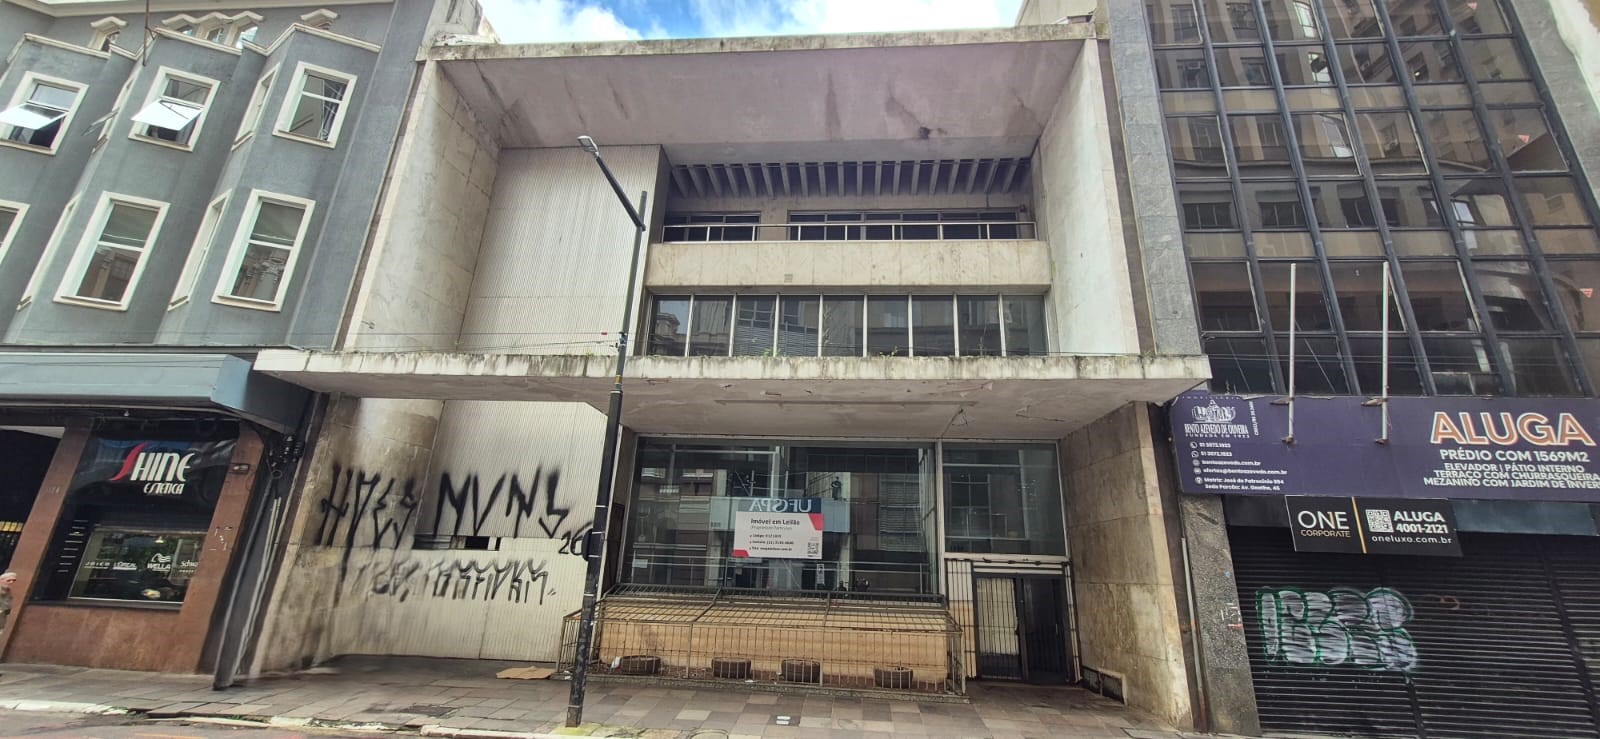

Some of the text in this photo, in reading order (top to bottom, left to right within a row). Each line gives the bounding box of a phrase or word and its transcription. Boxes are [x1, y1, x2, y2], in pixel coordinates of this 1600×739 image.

[1184, 423, 1200, 434] BENTO
[1200, 424, 1221, 434] AZEVEDO
[1228, 424, 1249, 435] OLIVEIRA
[1430, 411, 1596, 446] ALUGA
[109, 439, 195, 482] SHINE
[1440, 447, 1591, 463] PRÉDIO COM 1569M2
[1444, 462, 1498, 472] ELEVADOR
[1505, 462, 1536, 472] PÁTIO
[1538, 464, 1585, 473] INTERNO
[1484, 471, 1510, 479] COM
[1511, 471, 1600, 481] CHURRASQUEIRA
[1424, 477, 1600, 489] MEZANINO COM JARDIM DE INVER
[750, 517, 771, 525] Imóvel
[1297, 511, 1350, 530] ONE
[1394, 510, 1446, 522] ALUGA
[1300, 529, 1351, 538] CORPORATE
[1395, 523, 1449, 534] 4001-2121
[1371, 535, 1453, 545] oneluxo.com.br
